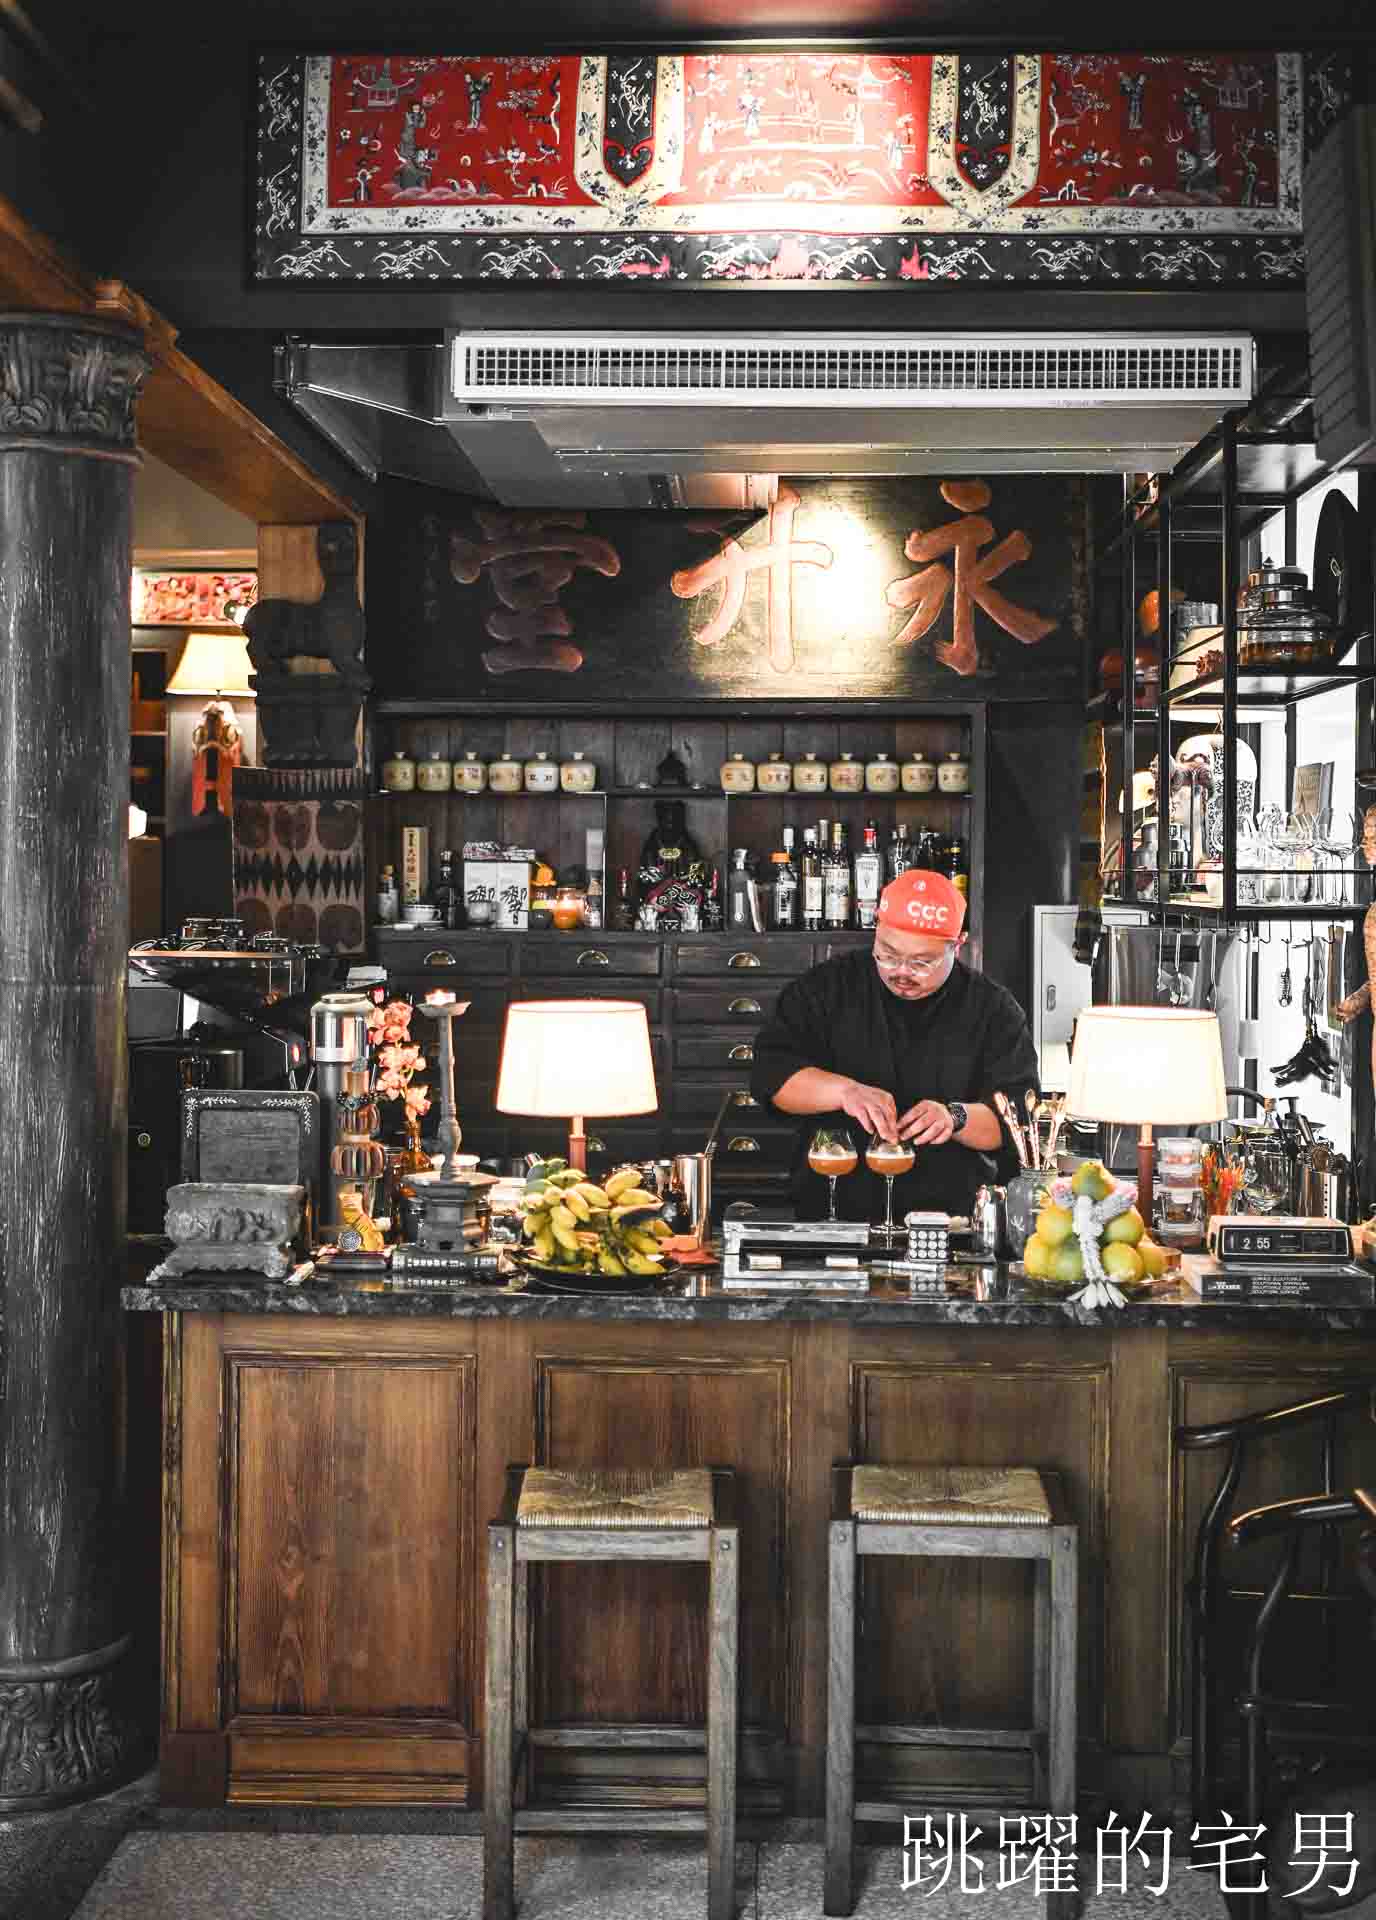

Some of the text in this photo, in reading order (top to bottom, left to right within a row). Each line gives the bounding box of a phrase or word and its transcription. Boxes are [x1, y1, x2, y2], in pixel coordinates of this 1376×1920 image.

[907, 900, 949, 922] CCC
[1241, 1237, 1271, 1250] 2 55
